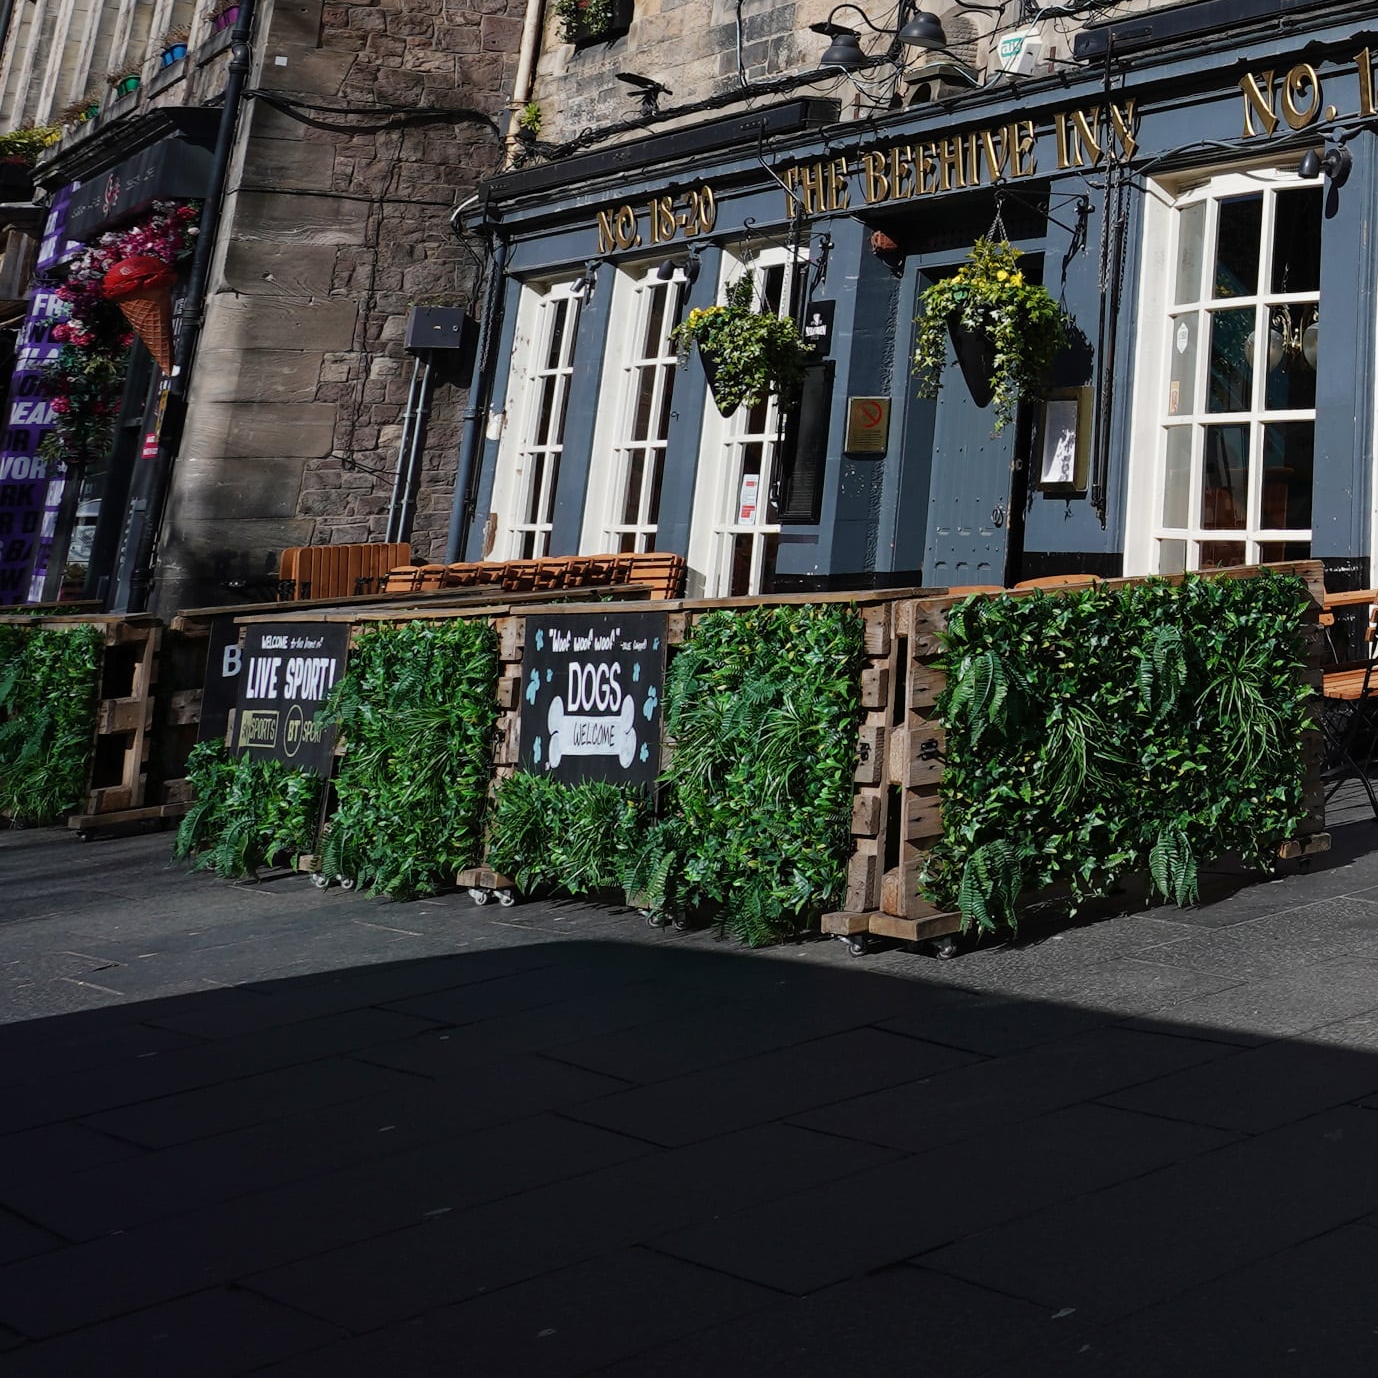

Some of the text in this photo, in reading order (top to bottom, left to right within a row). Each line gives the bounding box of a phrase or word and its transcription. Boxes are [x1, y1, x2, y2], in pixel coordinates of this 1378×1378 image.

[1238, 63, 1337, 140] NO.
[782, 97, 1140, 219] THE BEEHIVE INN
[597, 185, 714, 254] NO. 18-20
[246, 657, 337, 701] LIVE SPORT!
[567, 661, 622, 712] DOGS
[287, 720, 301, 742] BT
[573, 722, 615, 748] WELCOME
